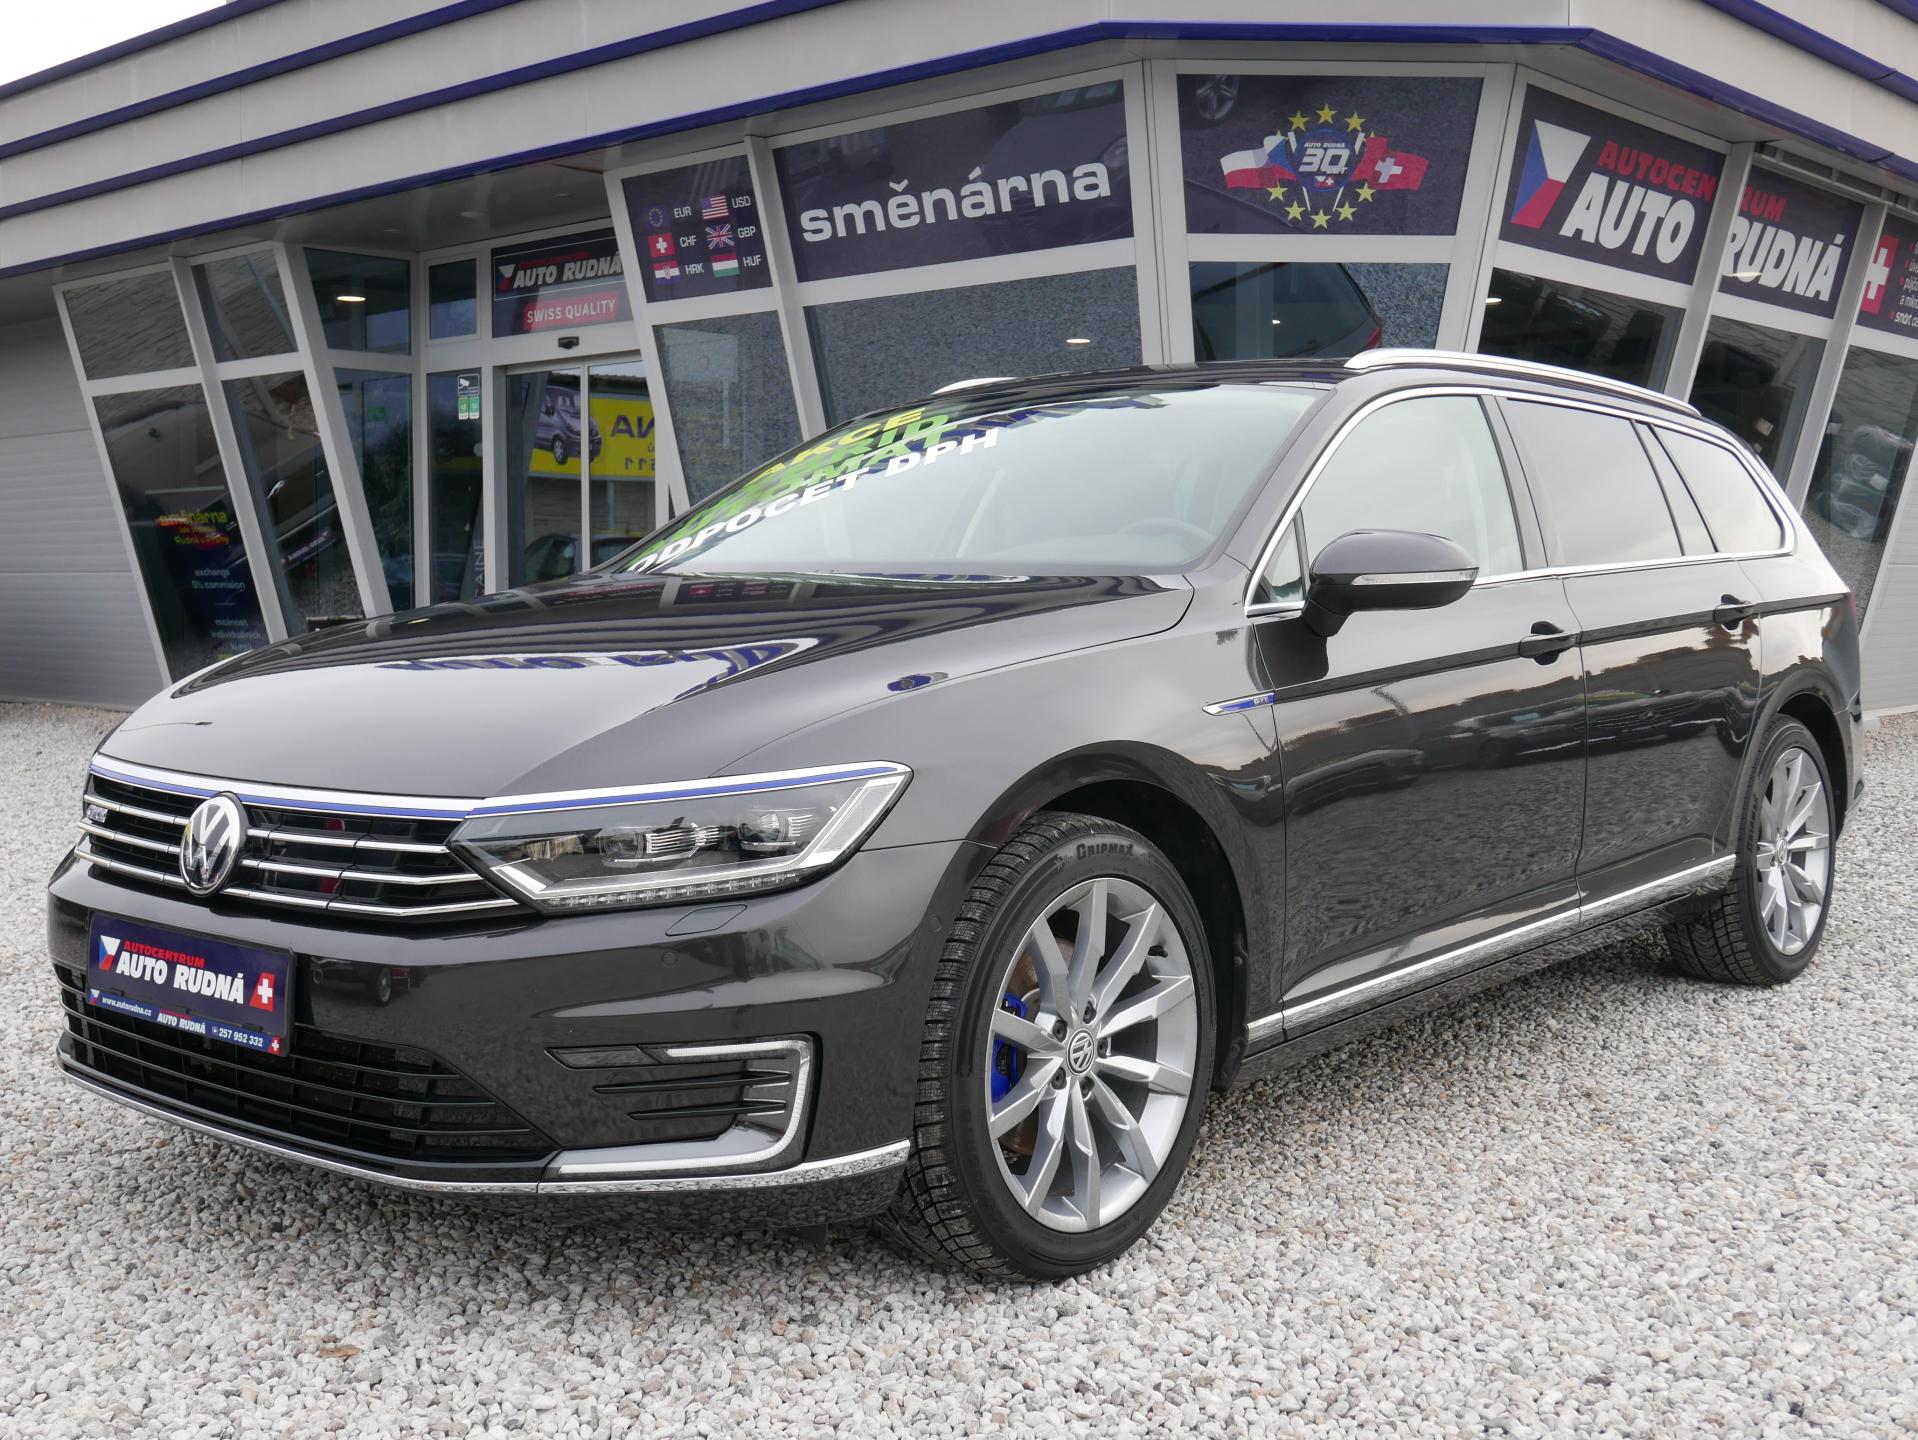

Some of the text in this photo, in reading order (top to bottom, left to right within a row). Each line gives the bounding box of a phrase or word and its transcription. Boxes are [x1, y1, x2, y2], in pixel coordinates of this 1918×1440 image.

[674, 206, 692, 218] EUR
[732, 195, 751, 209] USD
[800, 162, 1111, 242] směnárna
[680, 235, 697, 248] CHF
[737, 226, 756, 238] GBP
[1559, 172, 1845, 302] AUTO RUDNÁ
[513, 264, 558, 289] AUTO
[563, 250, 623, 281] RUDNÁ
[685, 263, 704, 275] HRK
[743, 255, 761, 267] HUF
[527, 299, 616, 323] SWISS QUALITY
[743, 407, 926, 488] AKCE
[885, 428, 998, 477] DPH
[123, 940, 205, 968] AUTOCENTRUM
[116, 951, 244, 1004] AUTO RUDNÁ
[102, 997, 152, 1017] www.autorudna.cz
[157, 1013, 177, 1027] AUTO
[178, 1019, 206, 1035] RUDNÁ
[218, 1027, 264, 1047] 257 952 332
